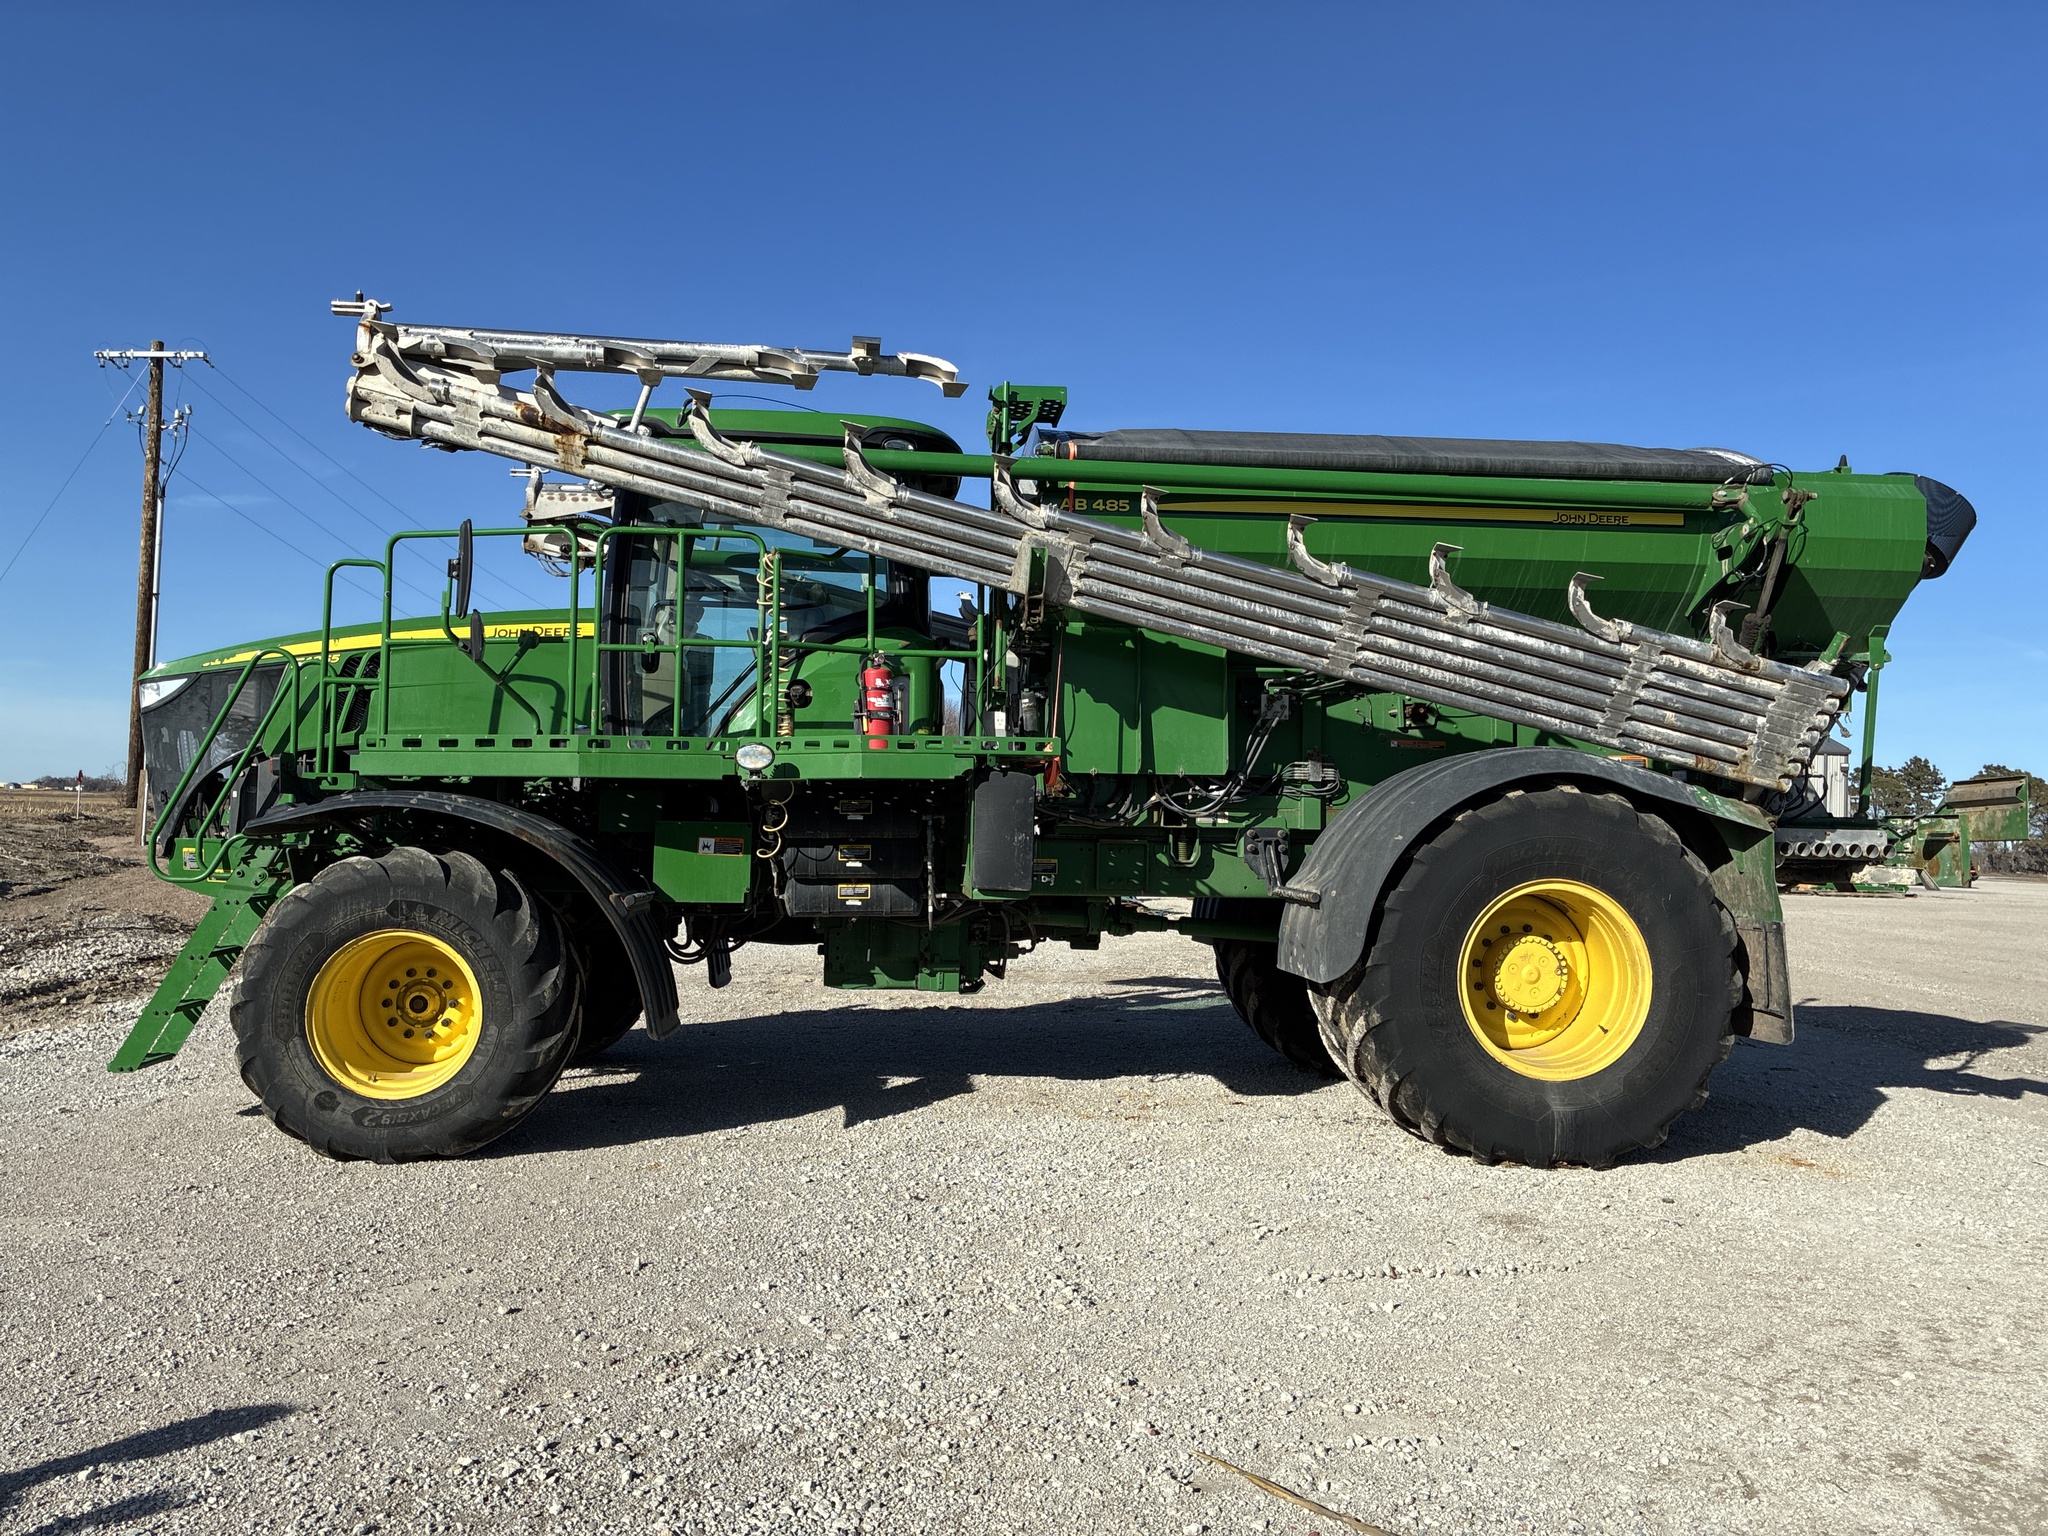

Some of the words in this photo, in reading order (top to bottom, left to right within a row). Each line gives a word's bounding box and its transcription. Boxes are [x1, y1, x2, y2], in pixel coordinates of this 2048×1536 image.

[1092, 499, 1130, 511] 485
[1553, 512, 1586, 523] JOHN
[1588, 513, 1630, 523] DEERE
